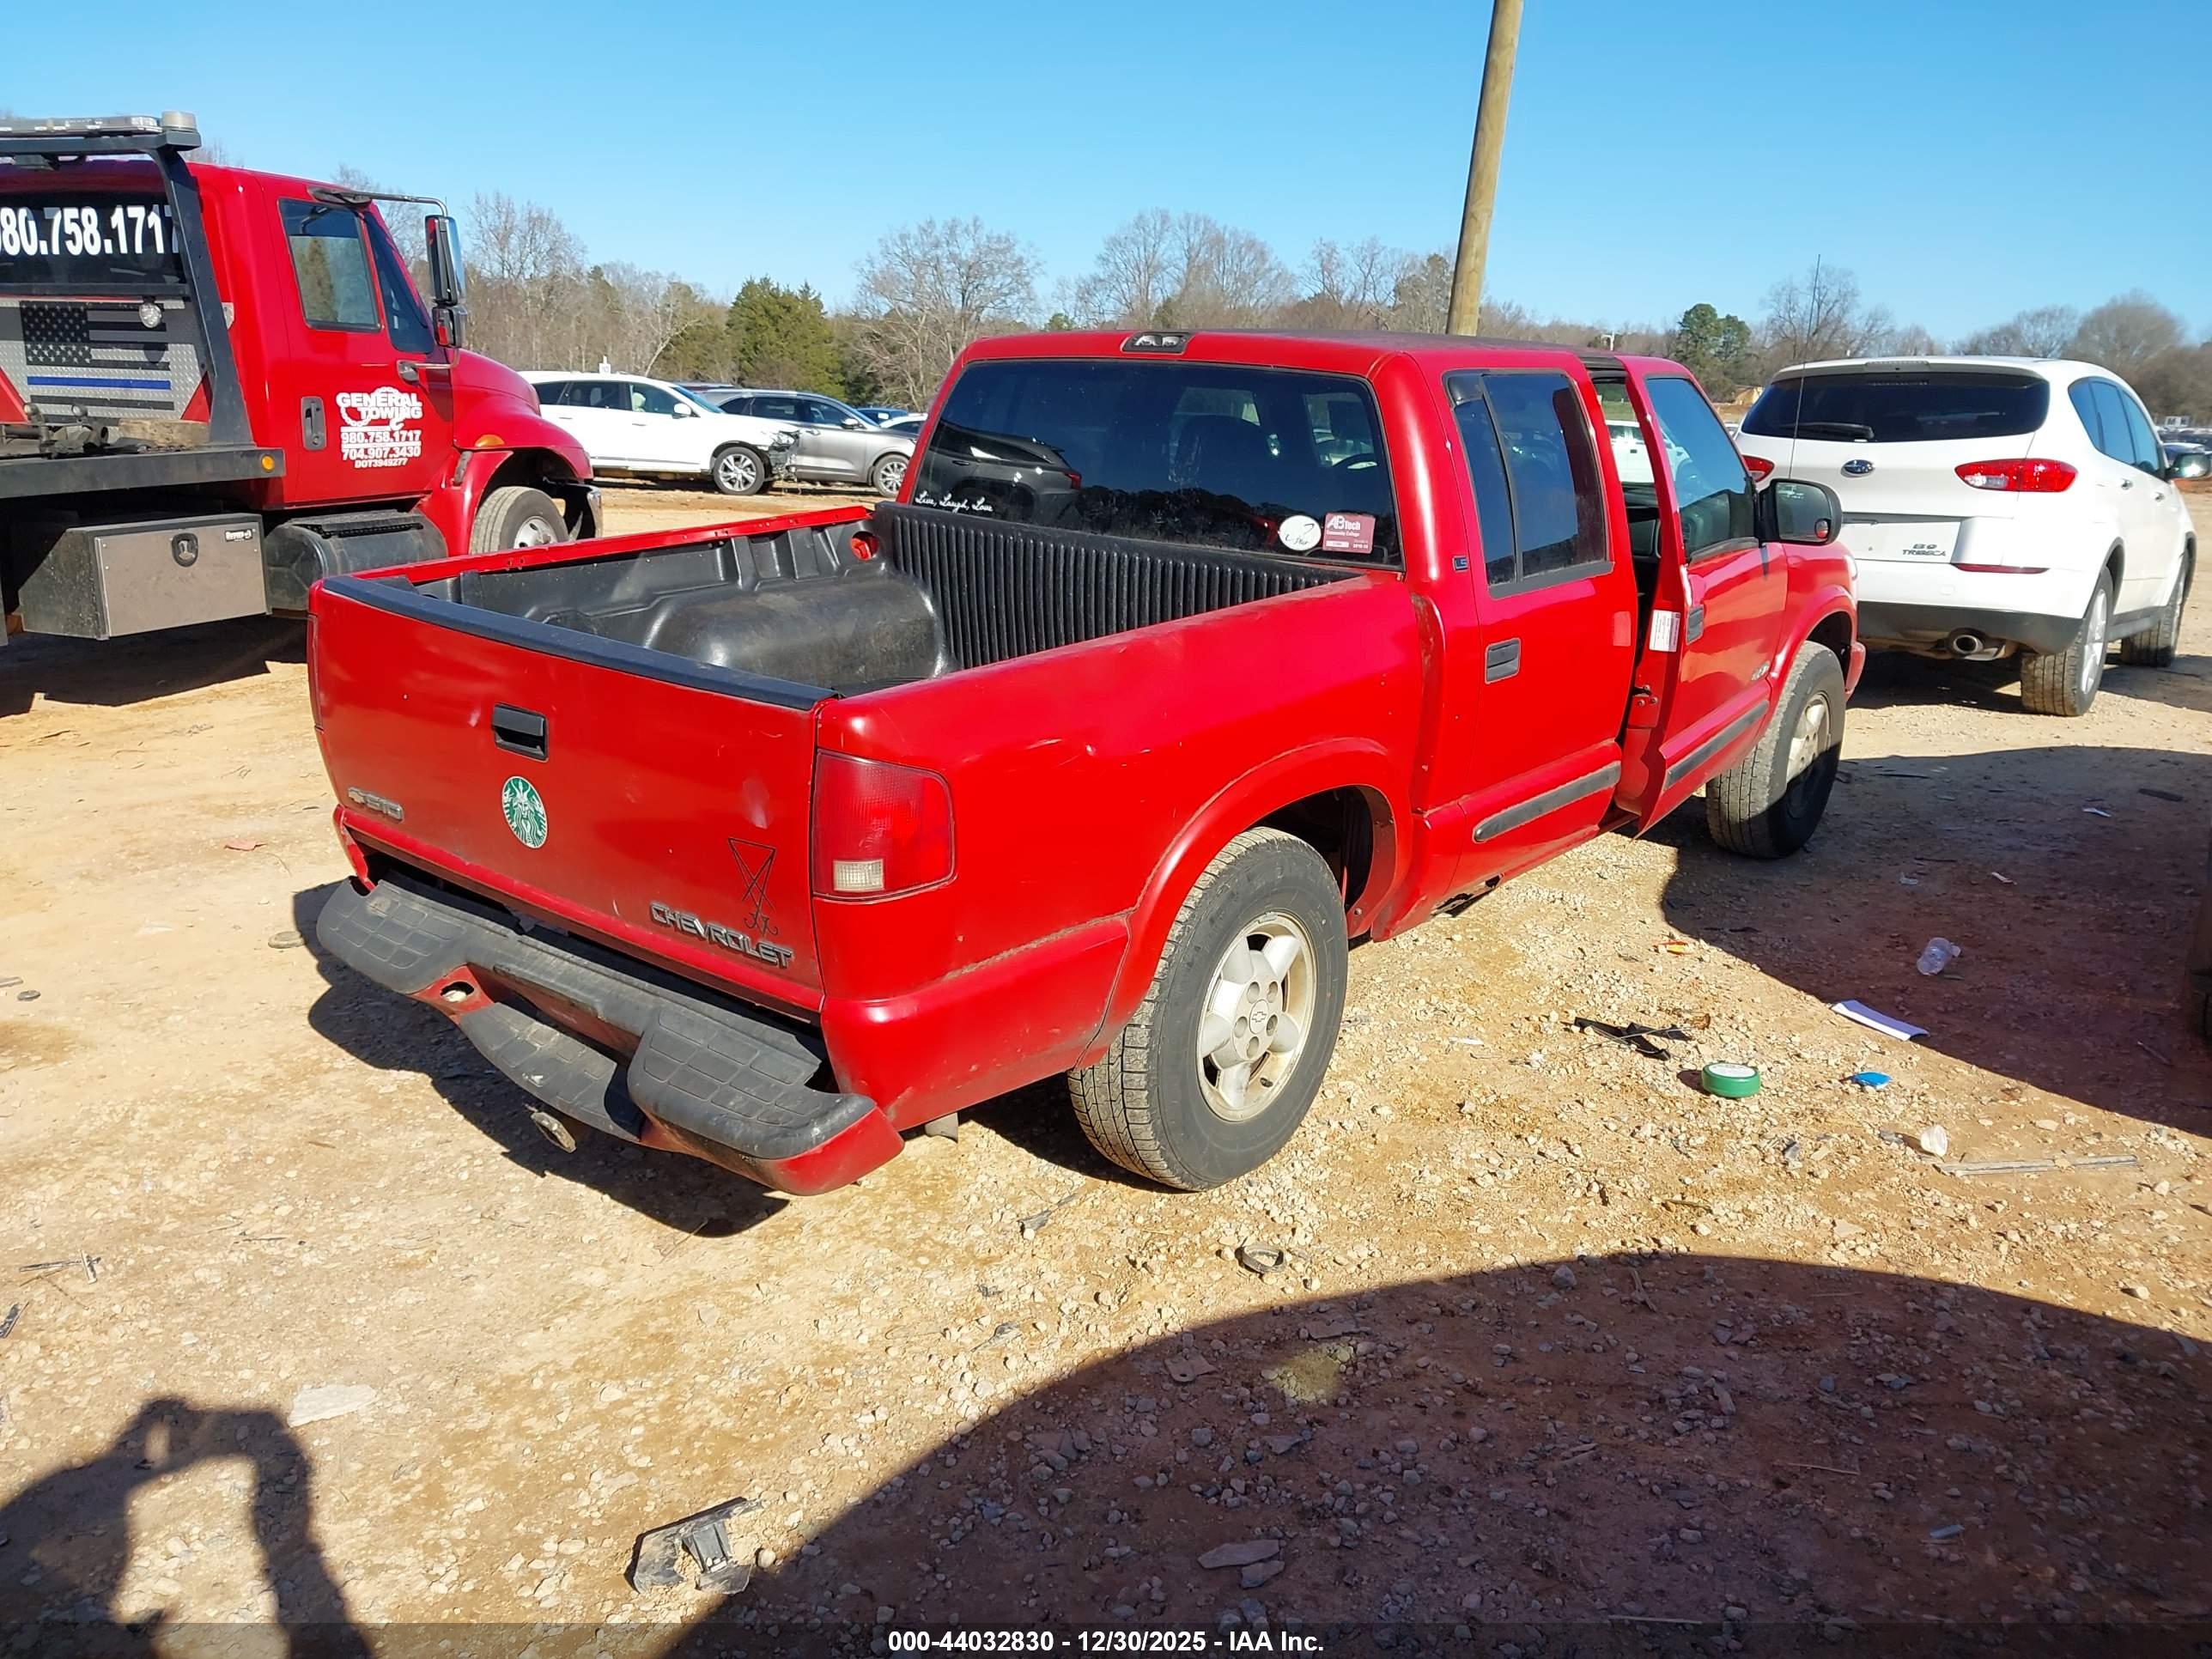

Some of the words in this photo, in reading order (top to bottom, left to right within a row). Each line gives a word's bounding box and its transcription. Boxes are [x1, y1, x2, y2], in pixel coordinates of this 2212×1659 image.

[0, 204, 179, 256] 80.758.171
[336, 392, 423, 408] GENERAL
[357, 406, 423, 420] TOWING
[340, 429, 422, 444] 980.758.1717
[342, 446, 422, 461] 704.907.3430
[939, 493, 969, 514] Laugh,
[971, 496, 994, 512] Love
[650, 902, 793, 969] CHEVROLET
